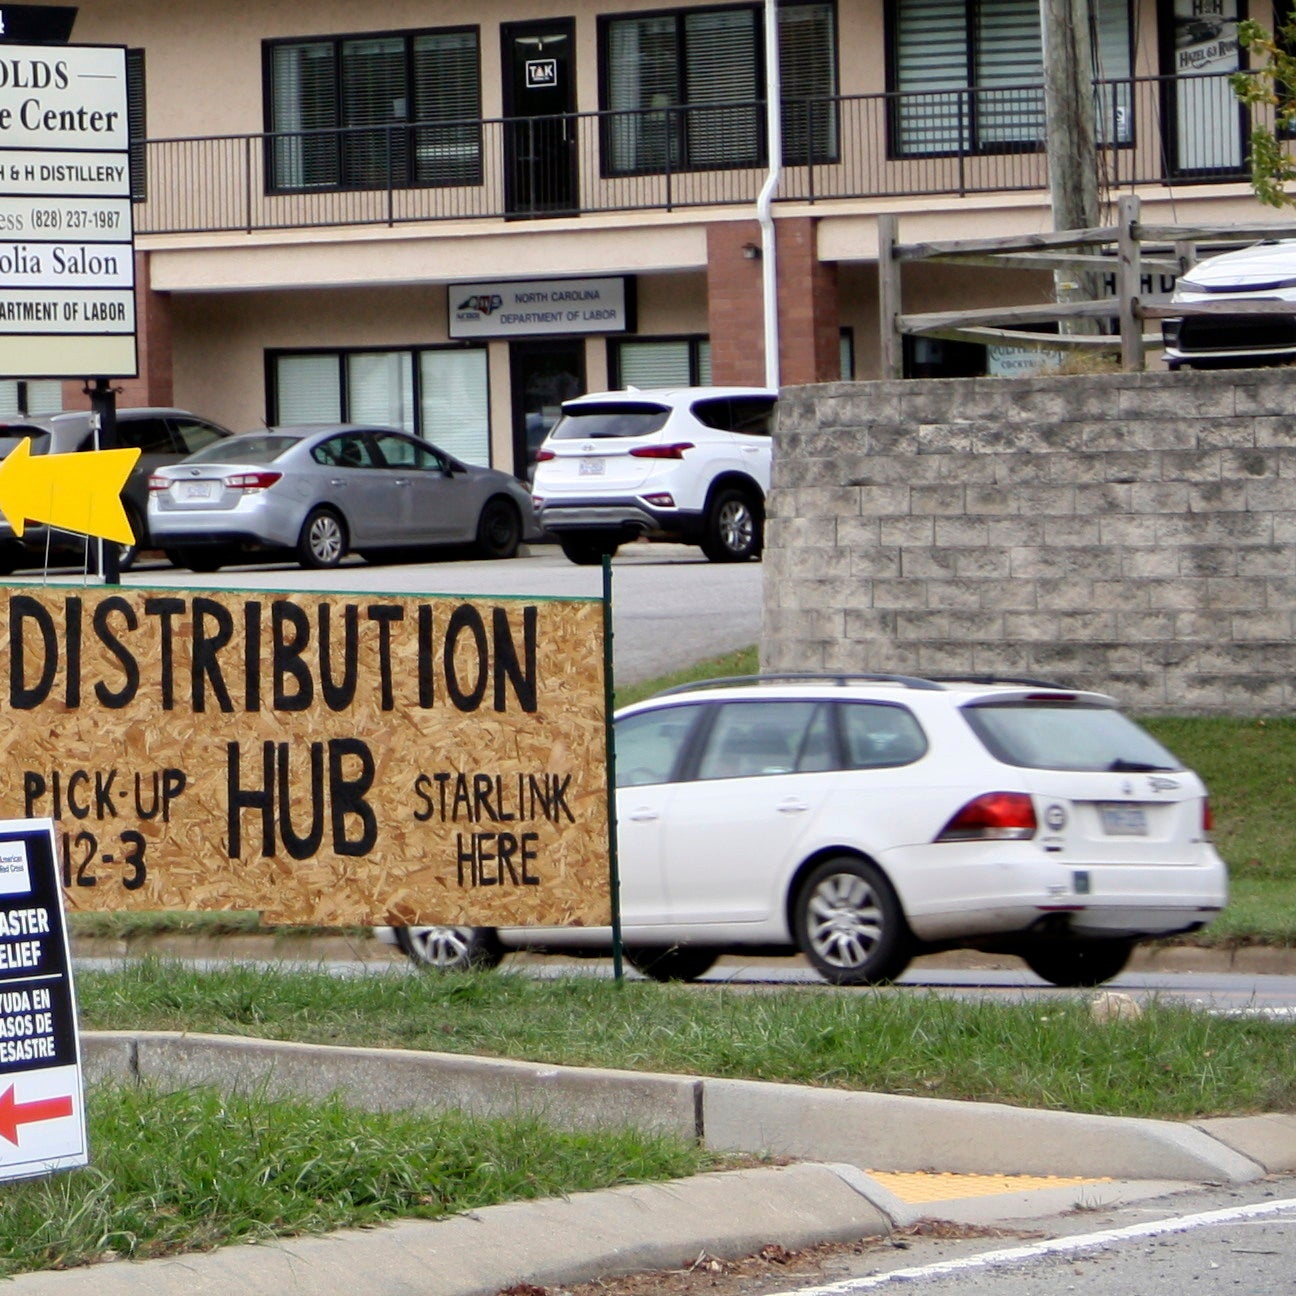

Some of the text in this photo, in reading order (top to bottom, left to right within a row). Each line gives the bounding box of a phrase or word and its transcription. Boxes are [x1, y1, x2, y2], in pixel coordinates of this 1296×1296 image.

[19, 98, 119, 132] Center
[10, 165, 20, 181] &
[24, 165, 35, 181] H
[39, 165, 125, 183] DISTILLERY
[30, 208, 62, 230] (828)
[66, 210, 121, 229] 237-1987
[52, 247, 119, 276] Salon
[551, 290, 600, 302] CAROLINA
[63, 303, 78, 321] OF
[83, 303, 126, 321] LABOR
[500, 311, 563, 324] DEPARTMENT
[583, 309, 617, 321] LABOR
[9, 595, 538, 713] DISTRIBUTION
[23, 768, 187, 822] PICK-UP
[226, 738, 378, 860] HUB
[413, 773, 576, 823] STARLINK
[63, 831, 148, 890] 12-3
[456, 832, 540, 887] HERE
[33, 988, 51, 1009] EN
[36, 1012, 53, 1033] DE
